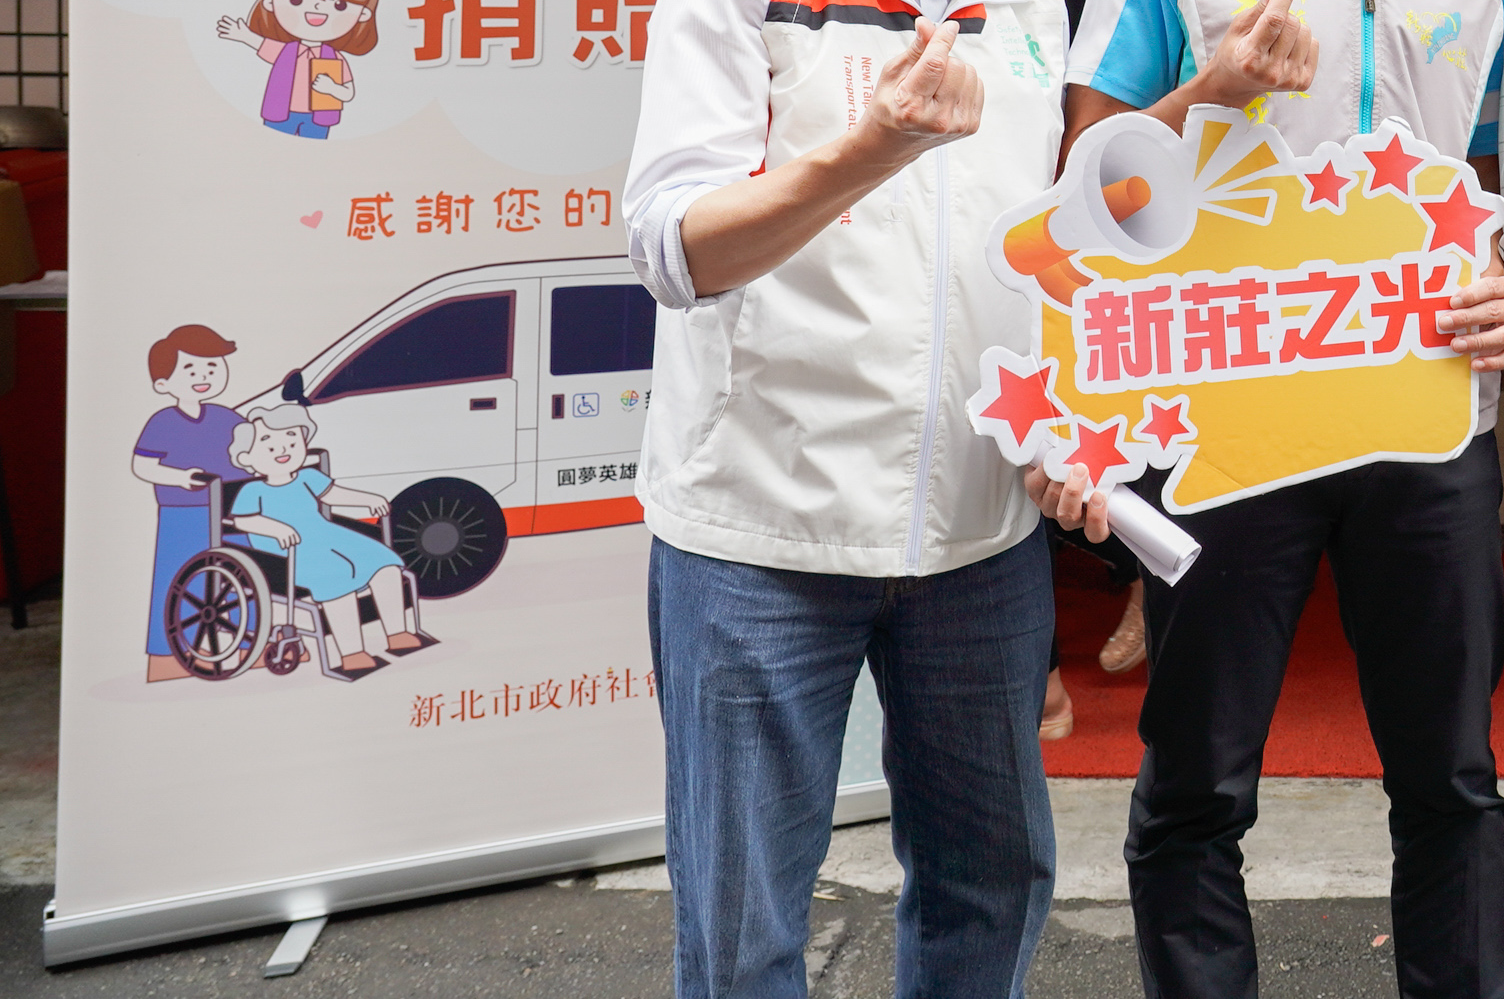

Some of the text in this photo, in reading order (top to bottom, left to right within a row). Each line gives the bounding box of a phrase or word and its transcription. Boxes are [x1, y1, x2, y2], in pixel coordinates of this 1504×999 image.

[861, 57, 873, 82] New
[348, 187, 612, 240] 感謝您的
[1084, 262, 1458, 382] 新莊之光
